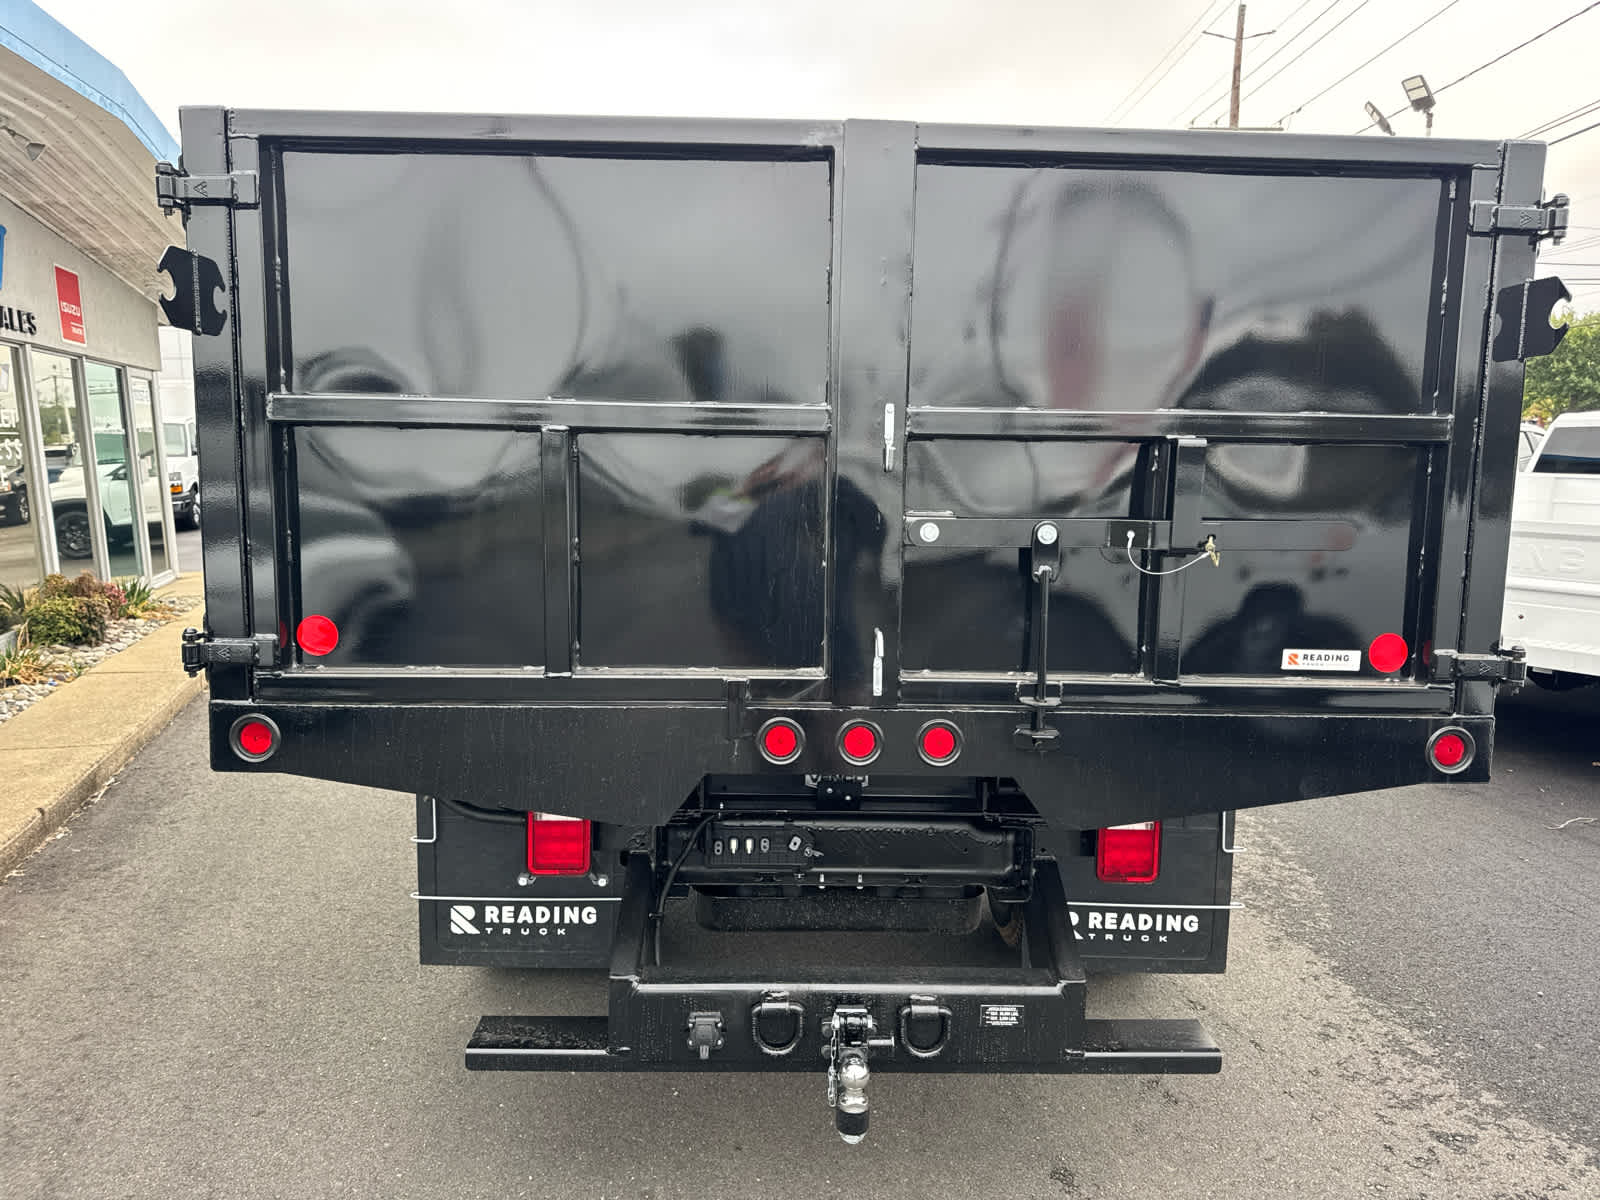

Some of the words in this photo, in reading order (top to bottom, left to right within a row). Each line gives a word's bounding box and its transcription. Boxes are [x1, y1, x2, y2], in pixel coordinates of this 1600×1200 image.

[60, 301, 81, 316] ISUZU
[1302, 653, 1350, 662] READING
[484, 905, 598, 925] READING
[1088, 911, 1200, 933] READING
[485, 927, 566, 936] TRUCK
[1088, 933, 1168, 943] TRUCK
